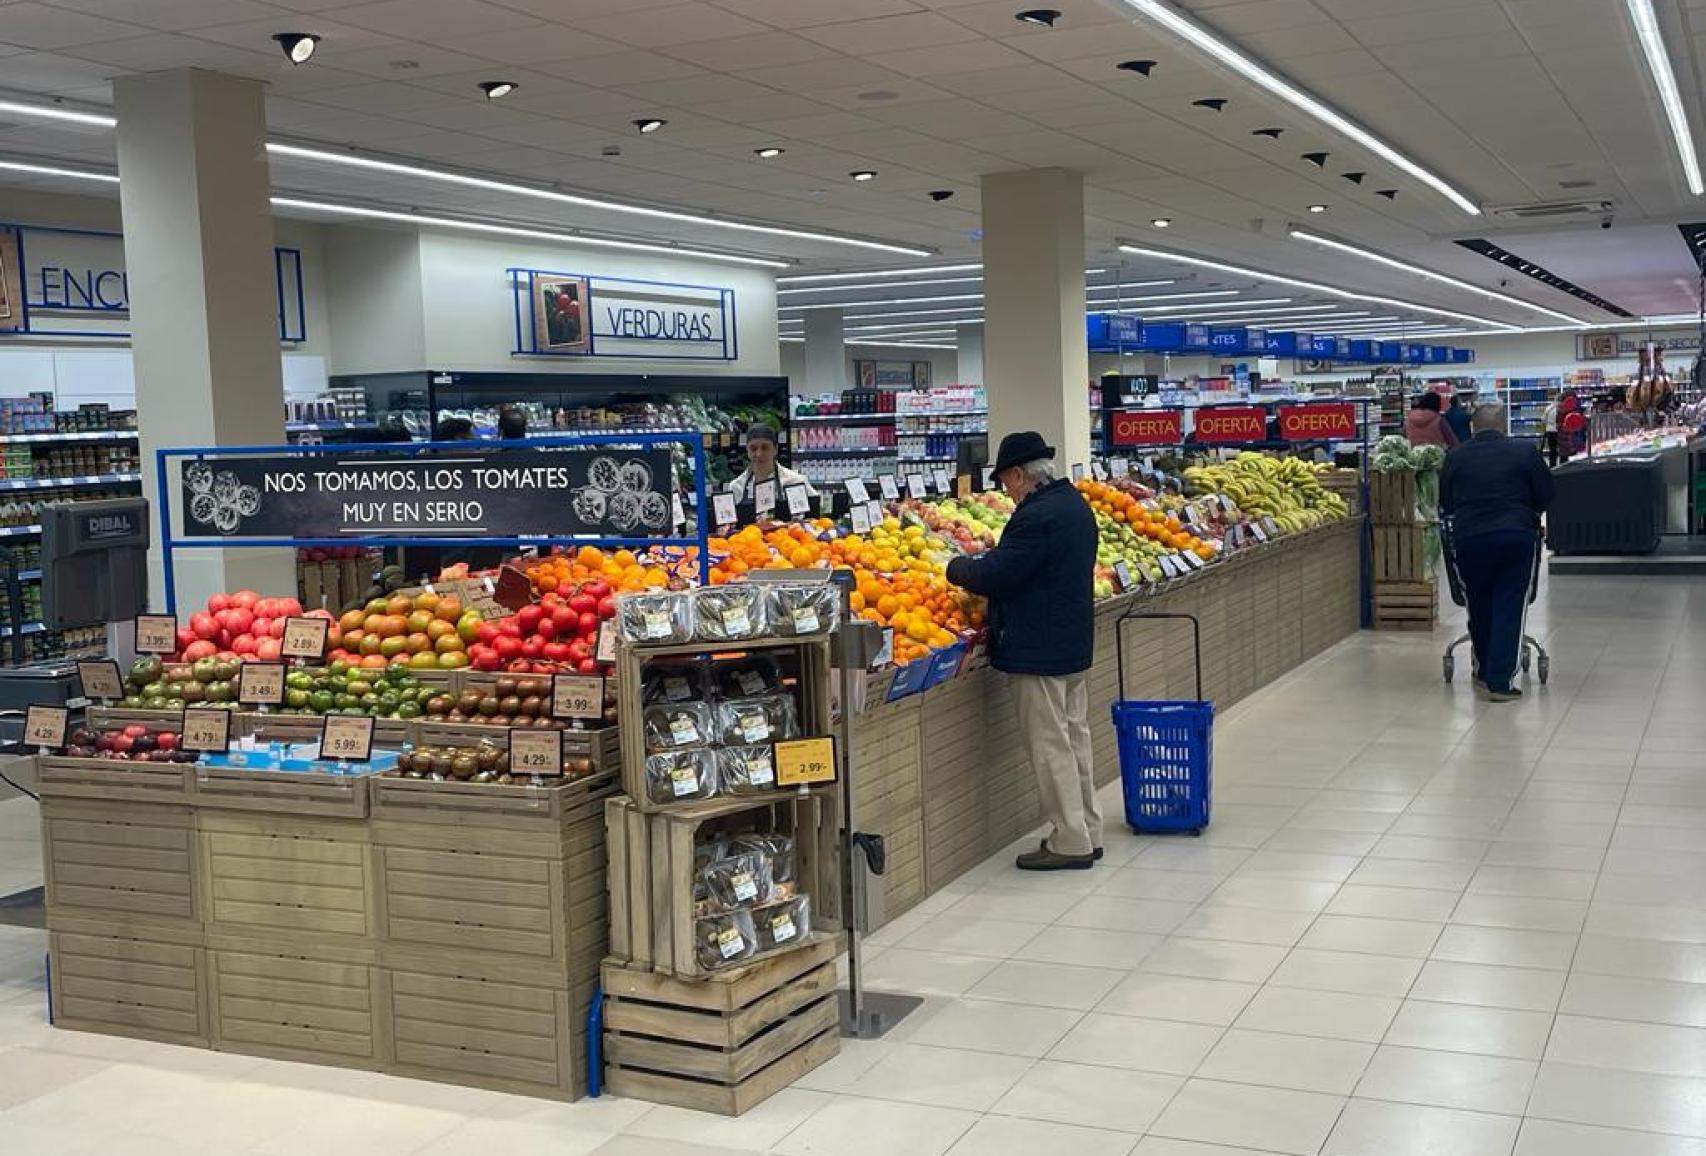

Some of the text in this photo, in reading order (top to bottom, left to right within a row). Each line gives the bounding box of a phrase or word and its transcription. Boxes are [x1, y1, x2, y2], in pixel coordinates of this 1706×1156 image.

[607, 306, 712, 339] VERDURAS
[1117, 420, 1177, 437] OFERTA
[1200, 417, 1261, 434] OFERTA
[1286, 414, 1350, 431] OFERTA
[264, 472, 306, 493] NOS
[424, 469, 464, 491] LOS
[471, 467, 569, 489] TOMATES
[343, 501, 483, 523] MUY EN SERIO
[89, 515, 131, 532] DIBAL
